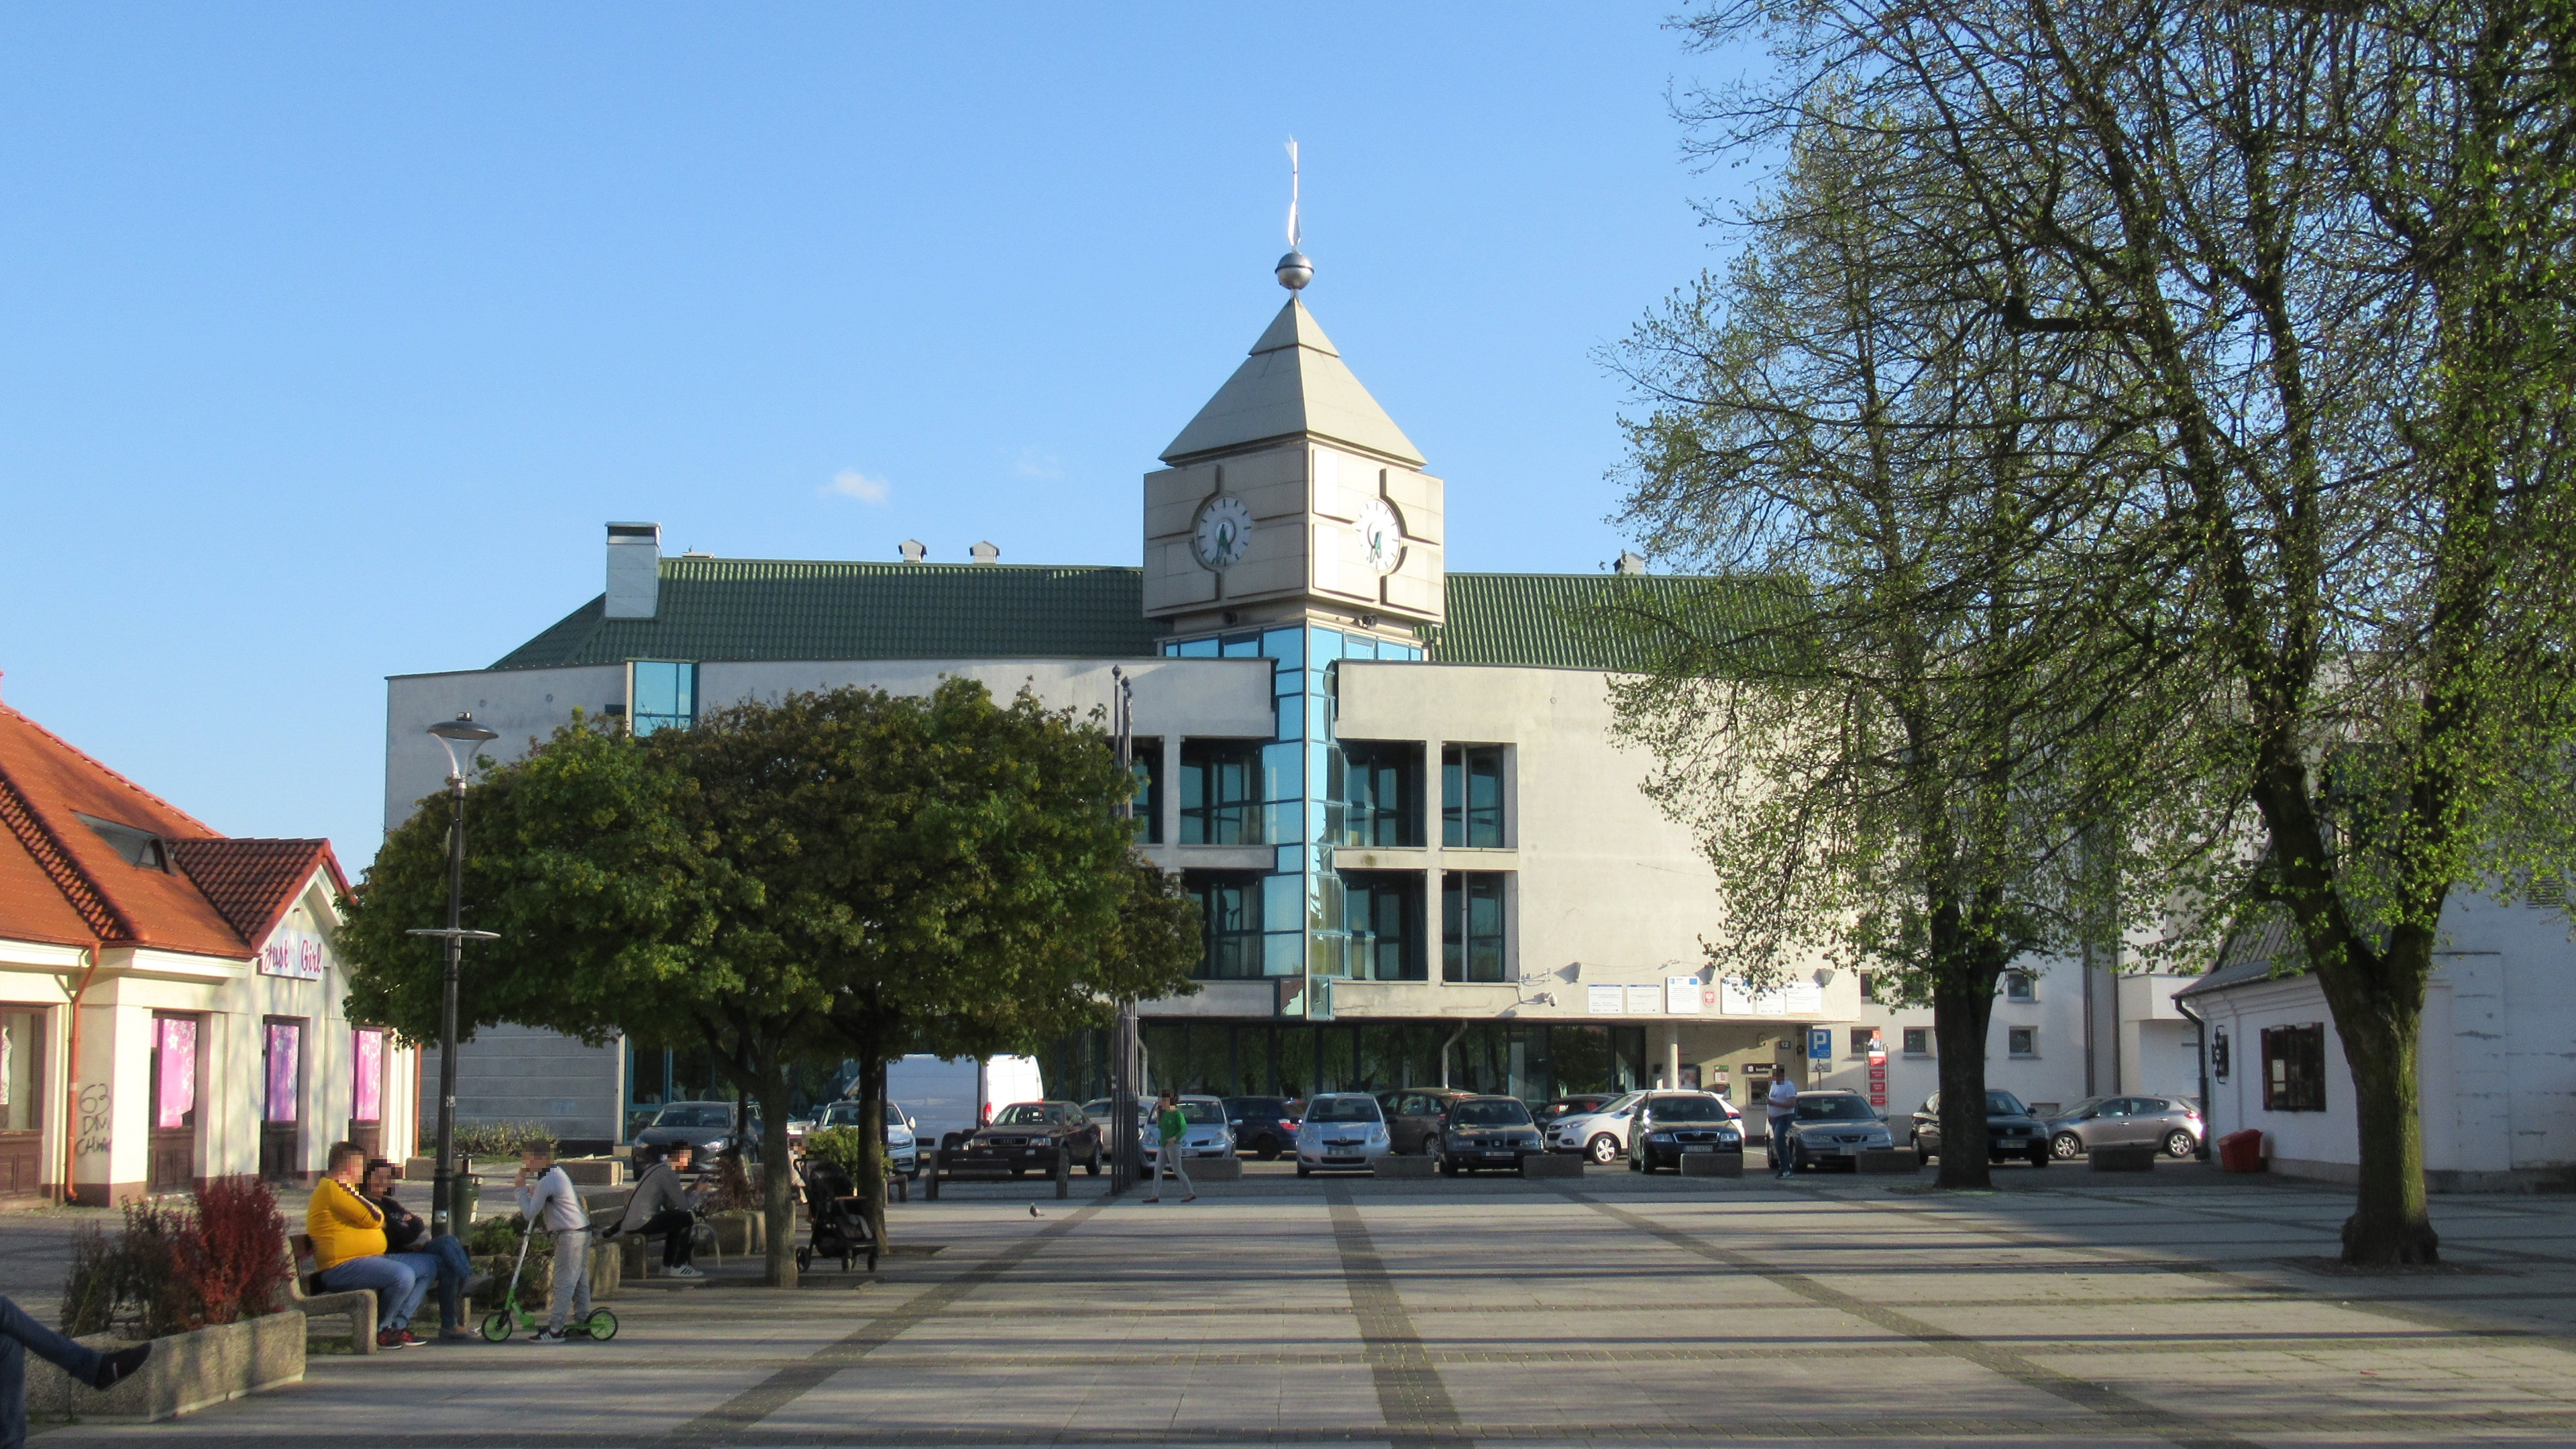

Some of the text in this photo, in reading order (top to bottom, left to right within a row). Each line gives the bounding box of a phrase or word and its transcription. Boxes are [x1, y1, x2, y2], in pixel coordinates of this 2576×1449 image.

[264, 940, 322, 973] Just Girl
[1813, 1032, 1827, 1050] P
[79, 1083, 111, 1114] 63
